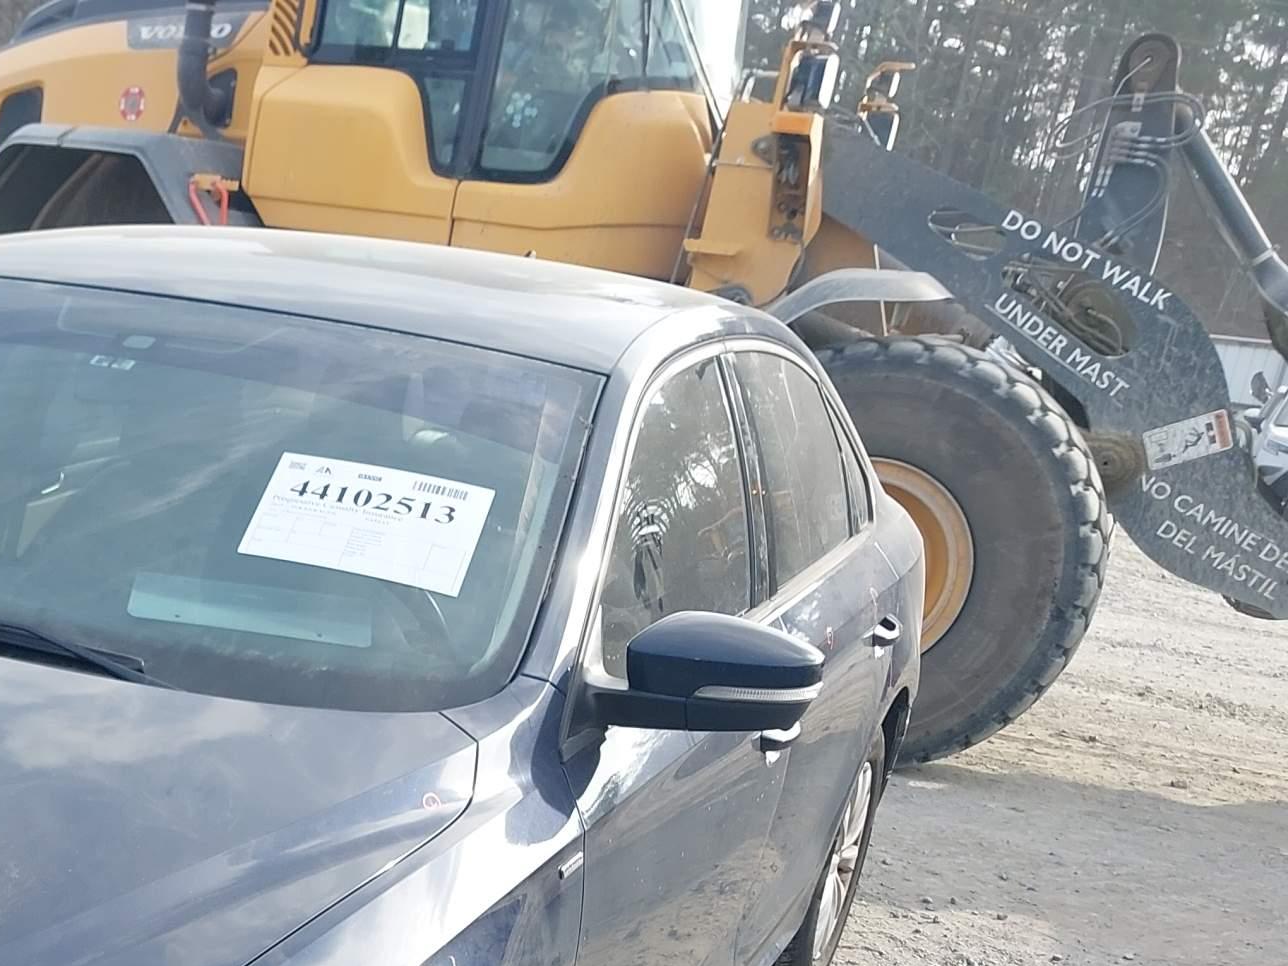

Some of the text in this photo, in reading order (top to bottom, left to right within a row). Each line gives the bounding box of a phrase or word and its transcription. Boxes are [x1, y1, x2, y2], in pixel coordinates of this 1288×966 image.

[1001, 209, 1173, 311] DO NOT WALK
[994, 293, 1130, 397] UNDER MAST
[289, 479, 457, 524] 44102513
[1173, 494, 1262, 552] CAMINE
[1156, 519, 1280, 600] DEL MÁSTIL
